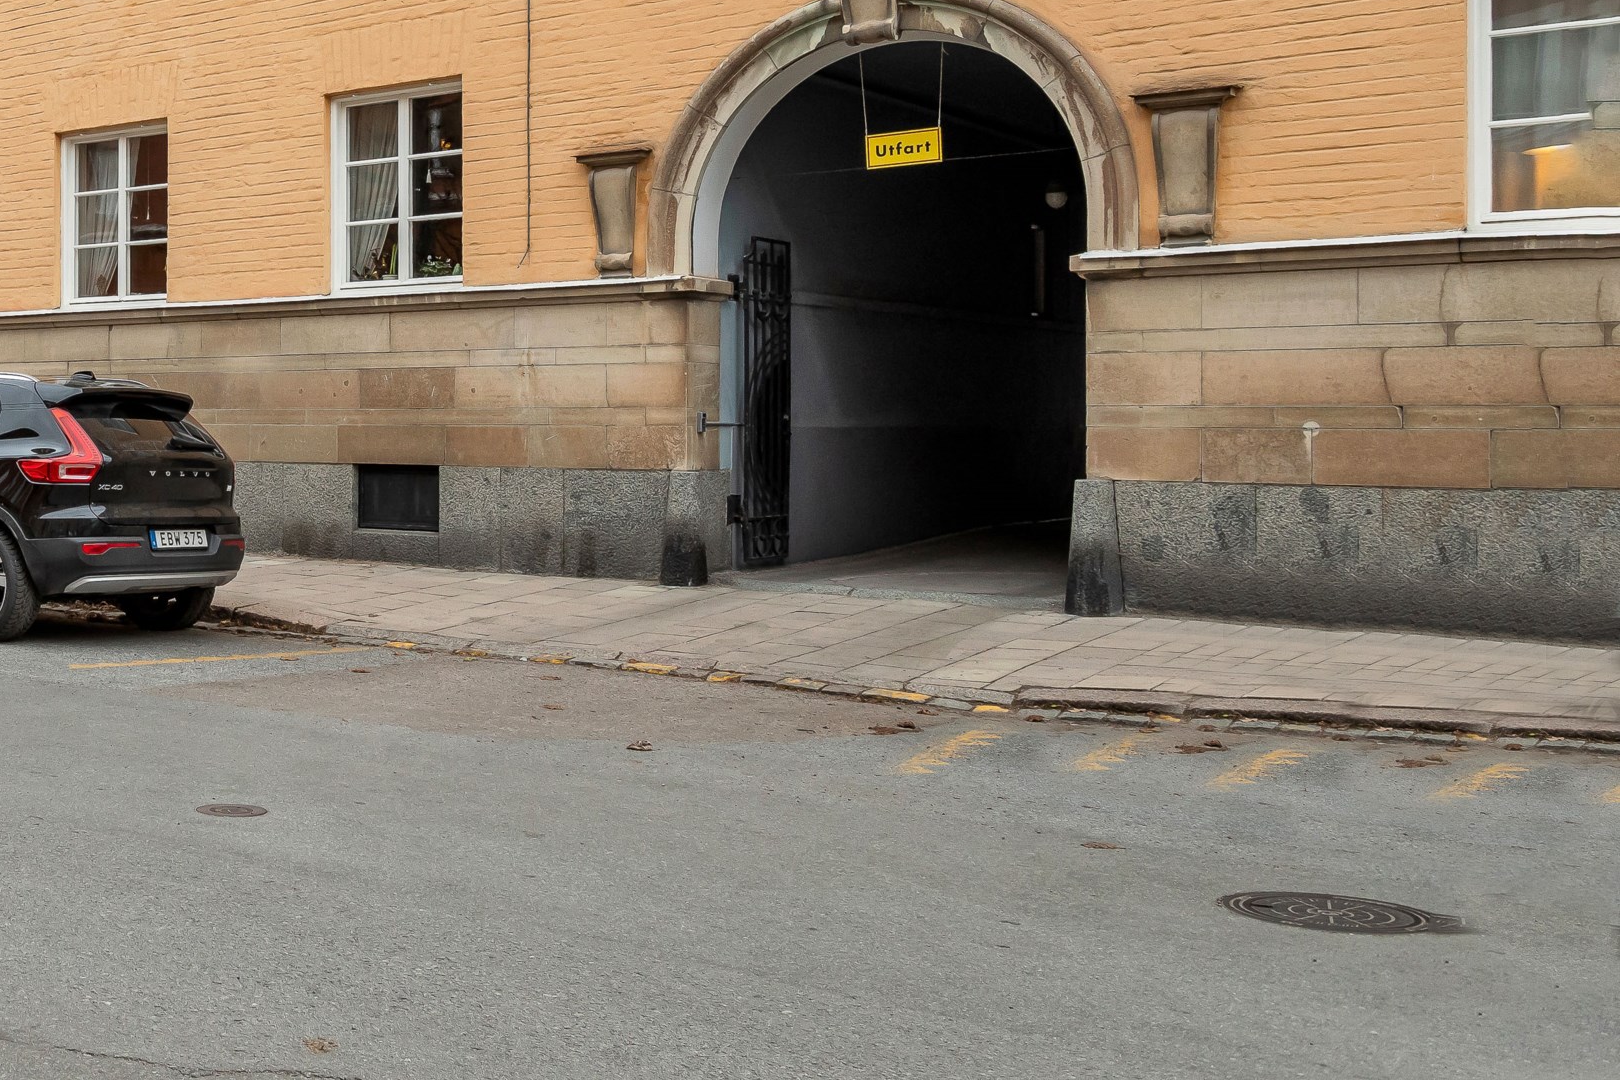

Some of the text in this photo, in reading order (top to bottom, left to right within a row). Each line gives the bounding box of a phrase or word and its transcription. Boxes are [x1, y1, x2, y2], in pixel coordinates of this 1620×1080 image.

[875, 141, 931, 158] Utfart
[149, 470, 211, 478] VOLVO
[98, 483, 124, 491] XC40
[159, 531, 204, 547] EBW 375
